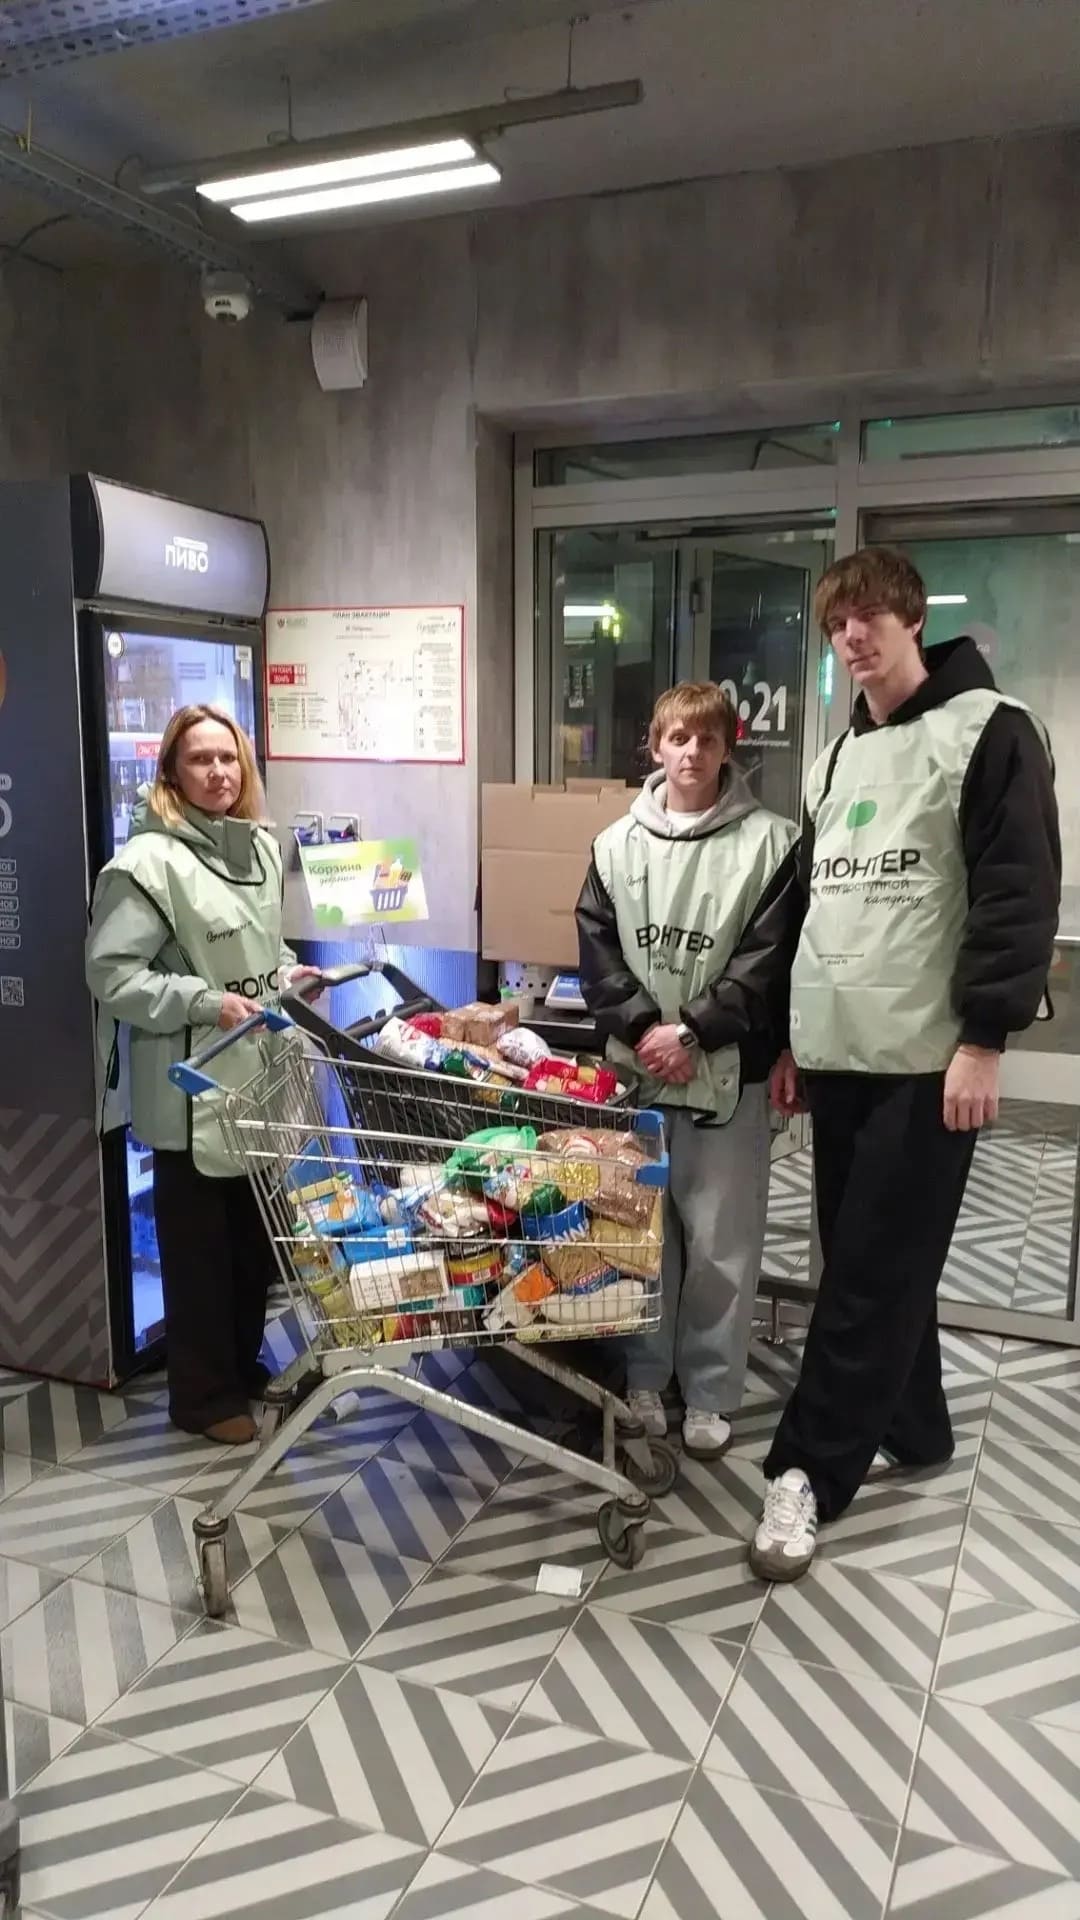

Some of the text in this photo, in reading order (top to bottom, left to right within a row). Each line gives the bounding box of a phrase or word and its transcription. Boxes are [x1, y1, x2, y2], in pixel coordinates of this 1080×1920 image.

[165, 544, 209, 573] ПИВО
[308, 863, 362, 877] Корзина
[811, 848, 921, 880] ЛОНТЕР
[635, 923, 715, 955] ВОНТЕР
[224, 967, 279, 999] ВОЛО
